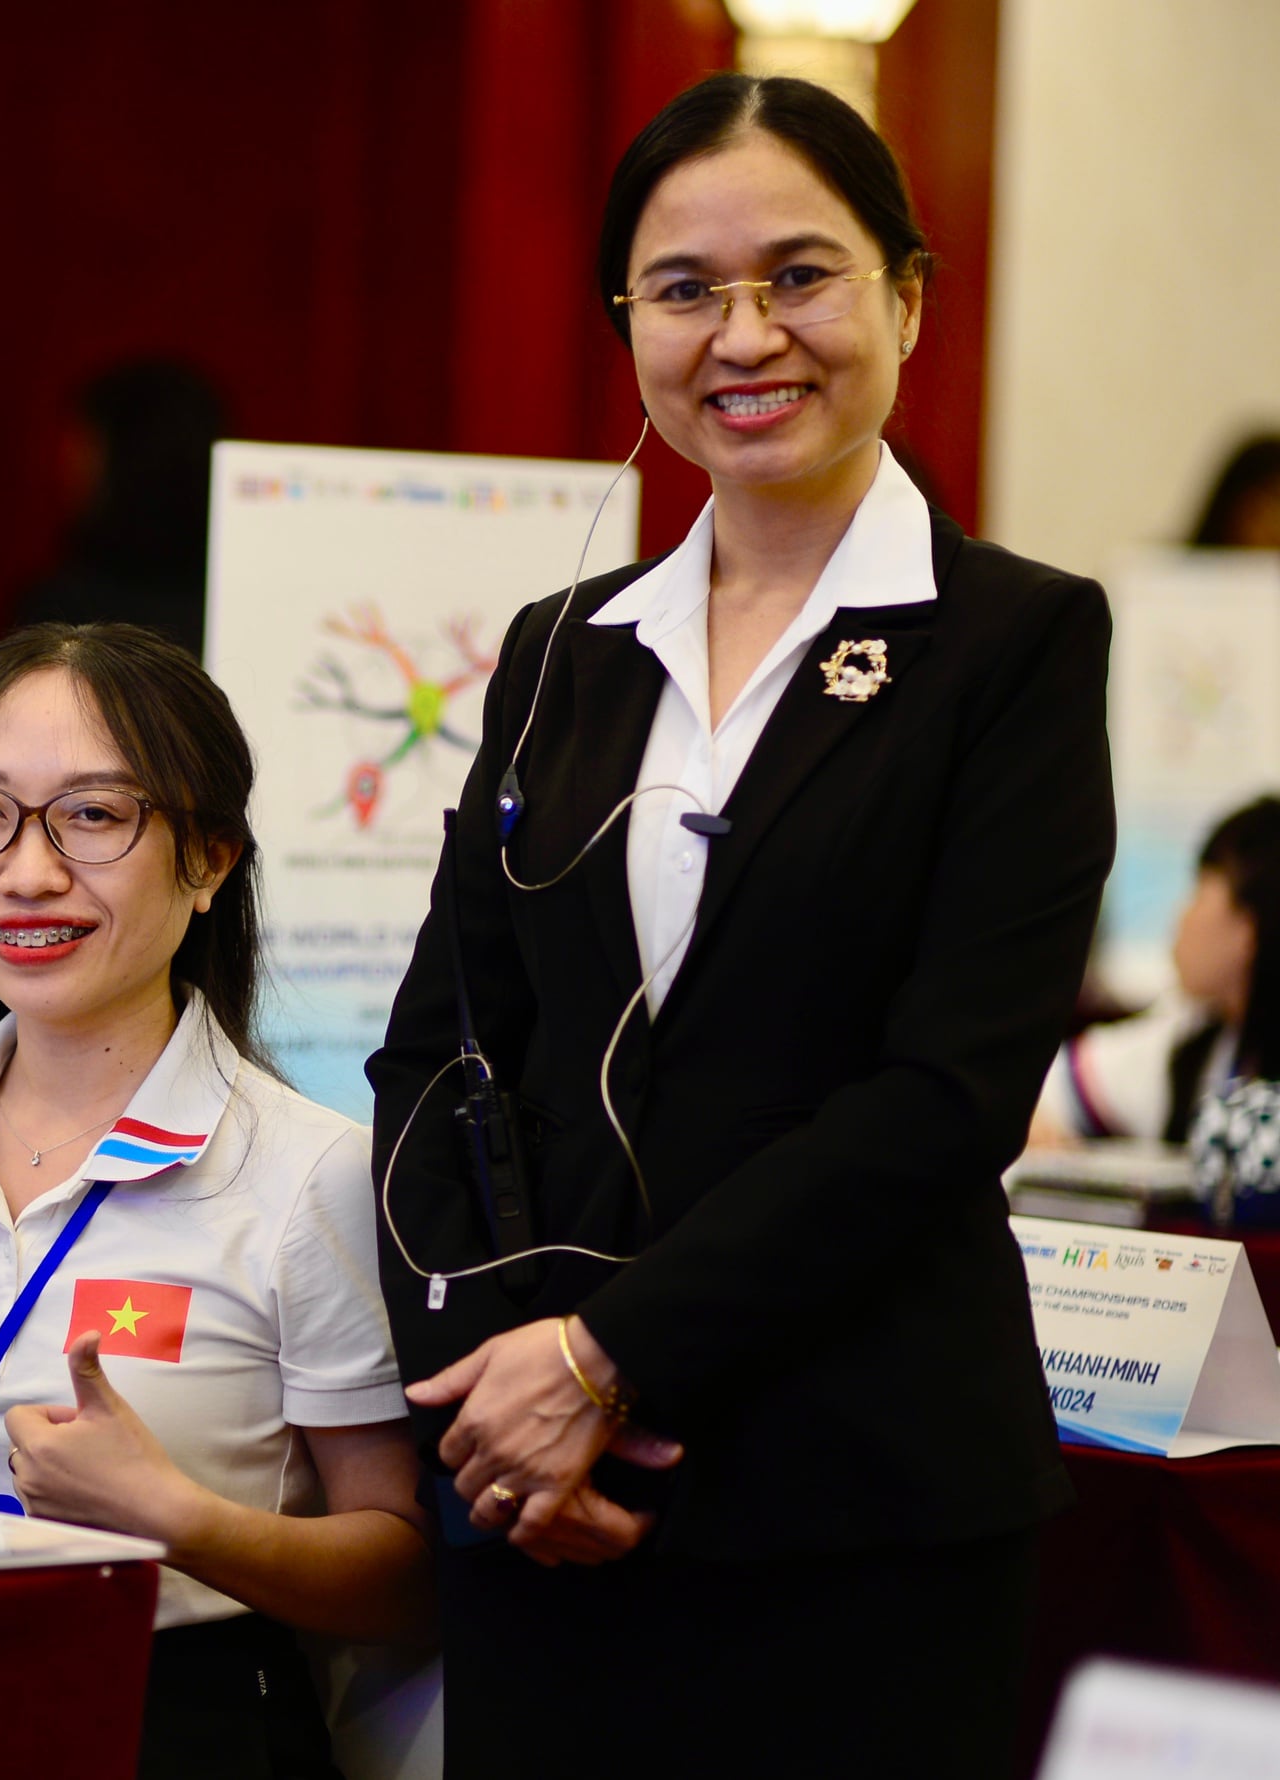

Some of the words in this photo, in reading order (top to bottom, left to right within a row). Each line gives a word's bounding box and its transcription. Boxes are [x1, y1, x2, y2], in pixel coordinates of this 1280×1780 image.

[1046, 1285, 1150, 1309] CHAMPIONSHIPS
[1152, 1299, 1188, 1313] 2025
[1045, 1349, 1112, 1379] KHANH
[1109, 1358, 1161, 1385] MINH
[1048, 1385, 1097, 1413] K024
